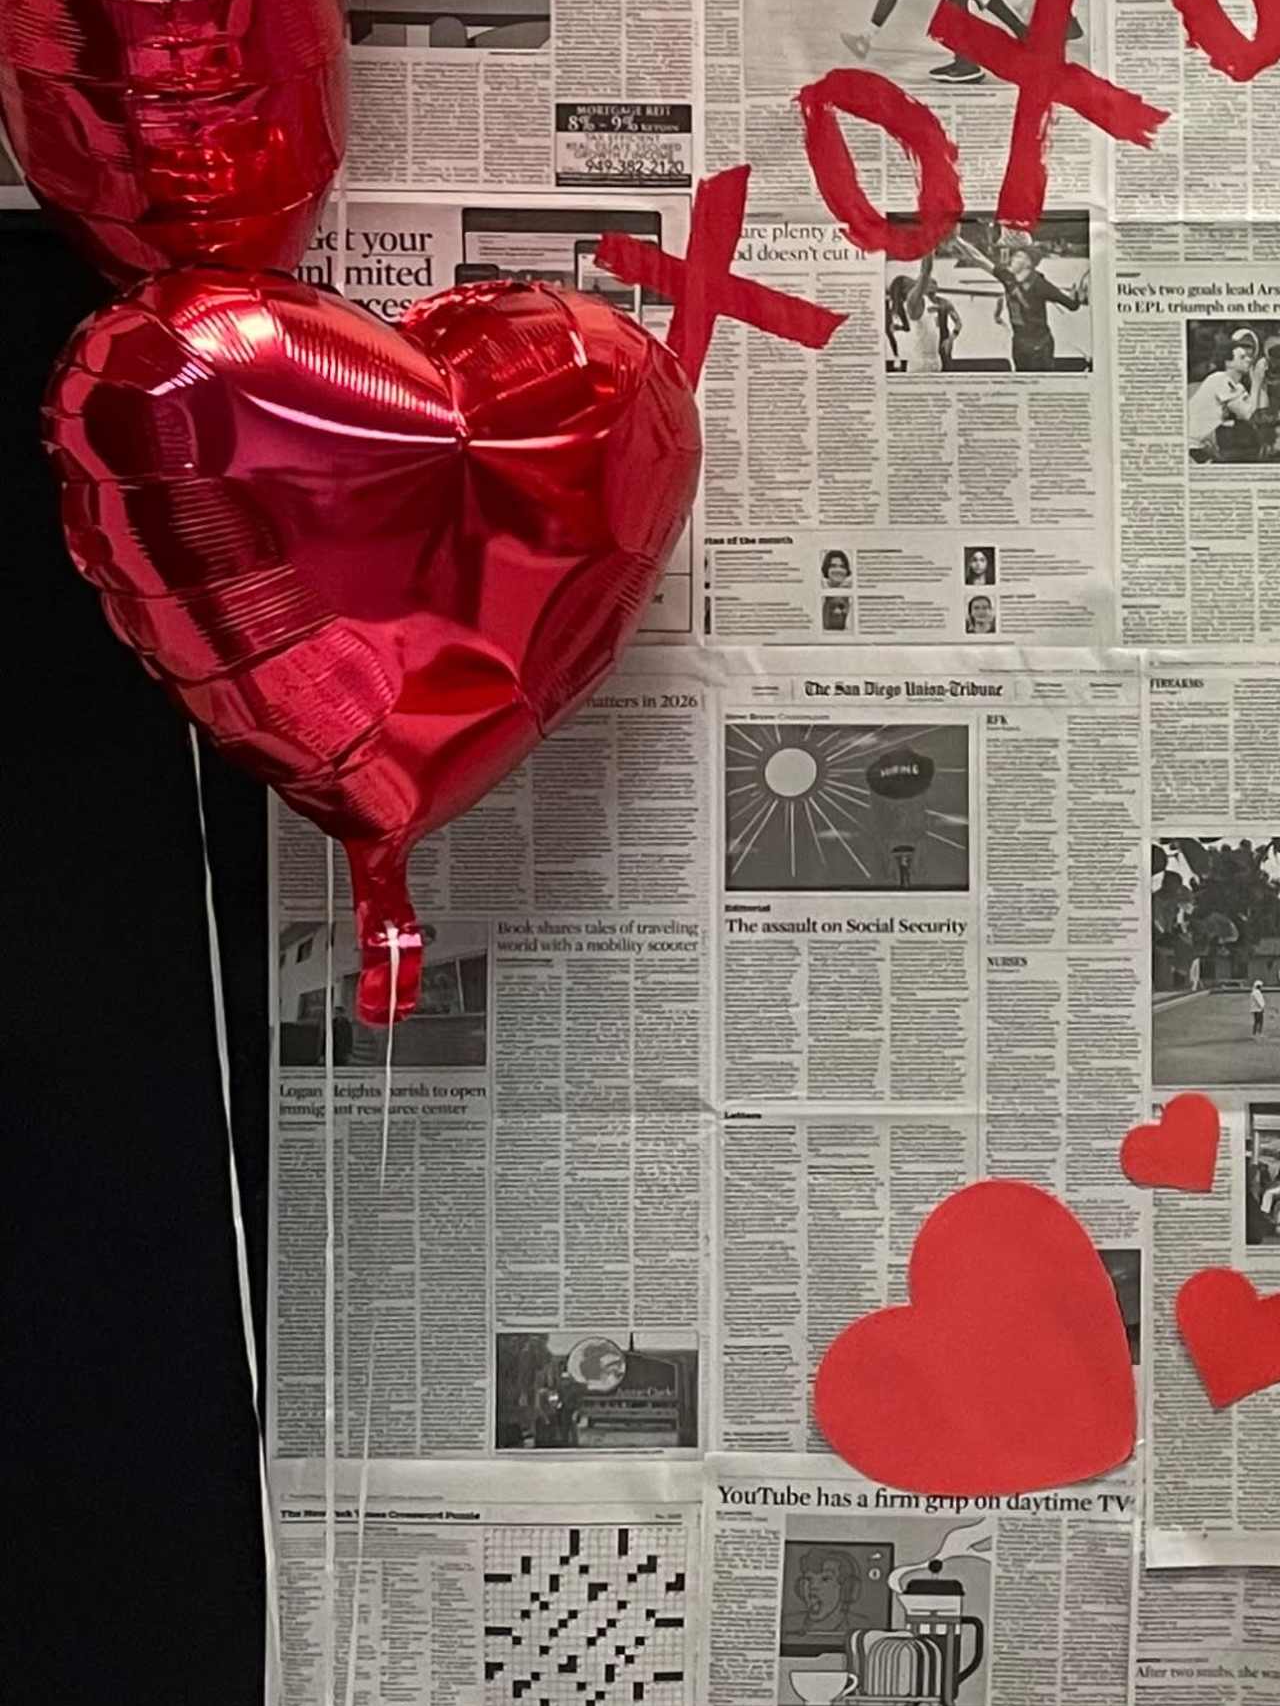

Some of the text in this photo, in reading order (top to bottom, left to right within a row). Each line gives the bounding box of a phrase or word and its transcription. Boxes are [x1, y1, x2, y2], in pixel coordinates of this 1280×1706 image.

[725, 917, 967, 937] The assault on Social Security
[716, 1485, 811, 1507] YouTube
[817, 1486, 851, 1507] has
[857, 1494, 868, 1507] a
[875, 1488, 919, 1508] firm
[1006, 1495, 1092, 1515] daytime
[1097, 1494, 1128, 1512] TV
